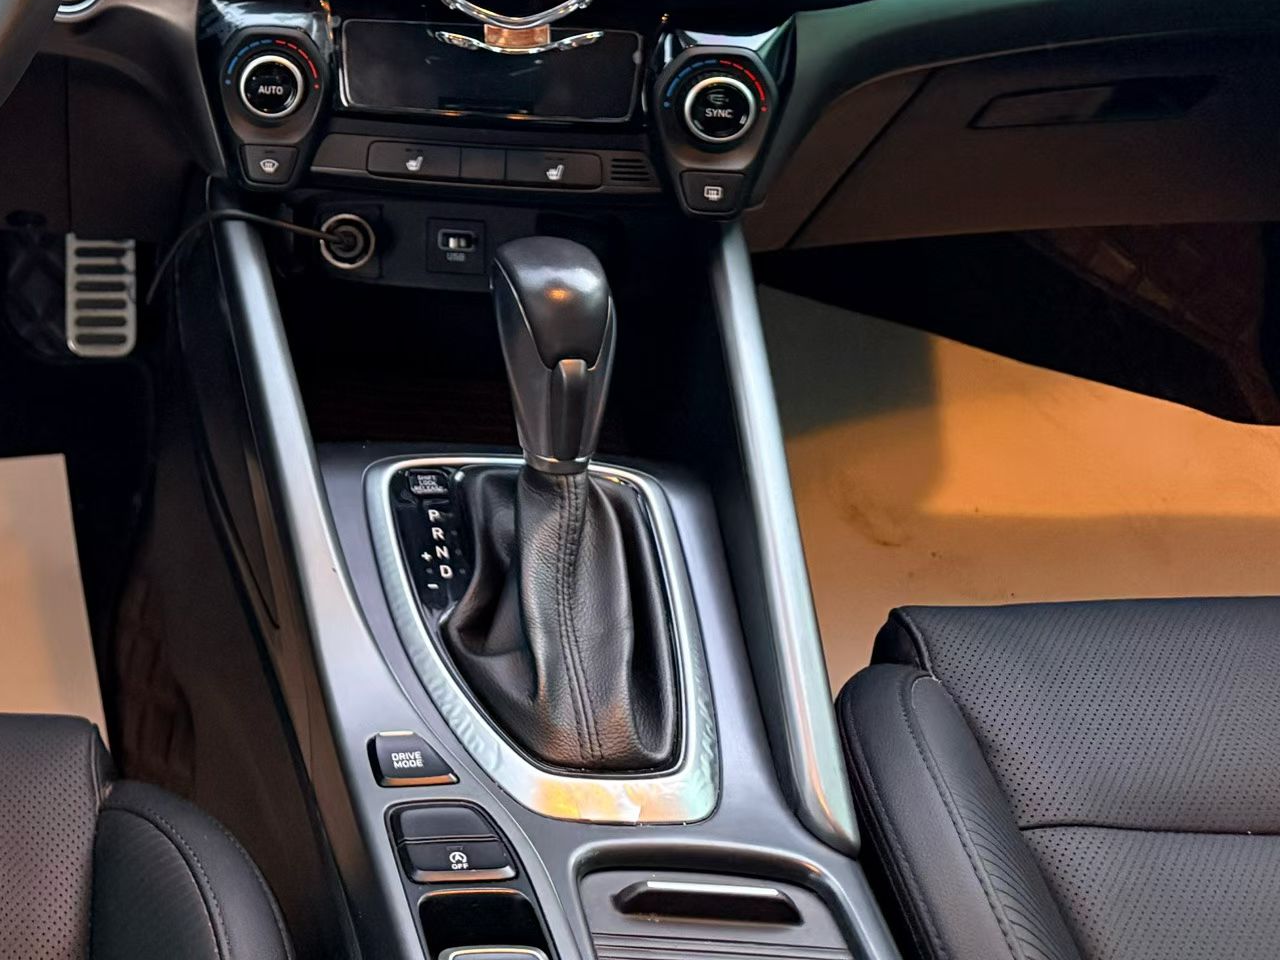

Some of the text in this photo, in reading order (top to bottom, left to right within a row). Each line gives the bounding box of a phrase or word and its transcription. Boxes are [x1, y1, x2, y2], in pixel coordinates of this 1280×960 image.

[257, 85, 284, 95] AUTO
[705, 107, 734, 118] SYNC
[428, 509, 440, 522] P
[431, 527, 445, 540] R
[435, 545, 450, 559] N
[439, 564, 453, 579] D
[391, 751, 422, 760] DRIVE
[393, 759, 423, 769] MODE
[451, 862, 469, 870] OFF
